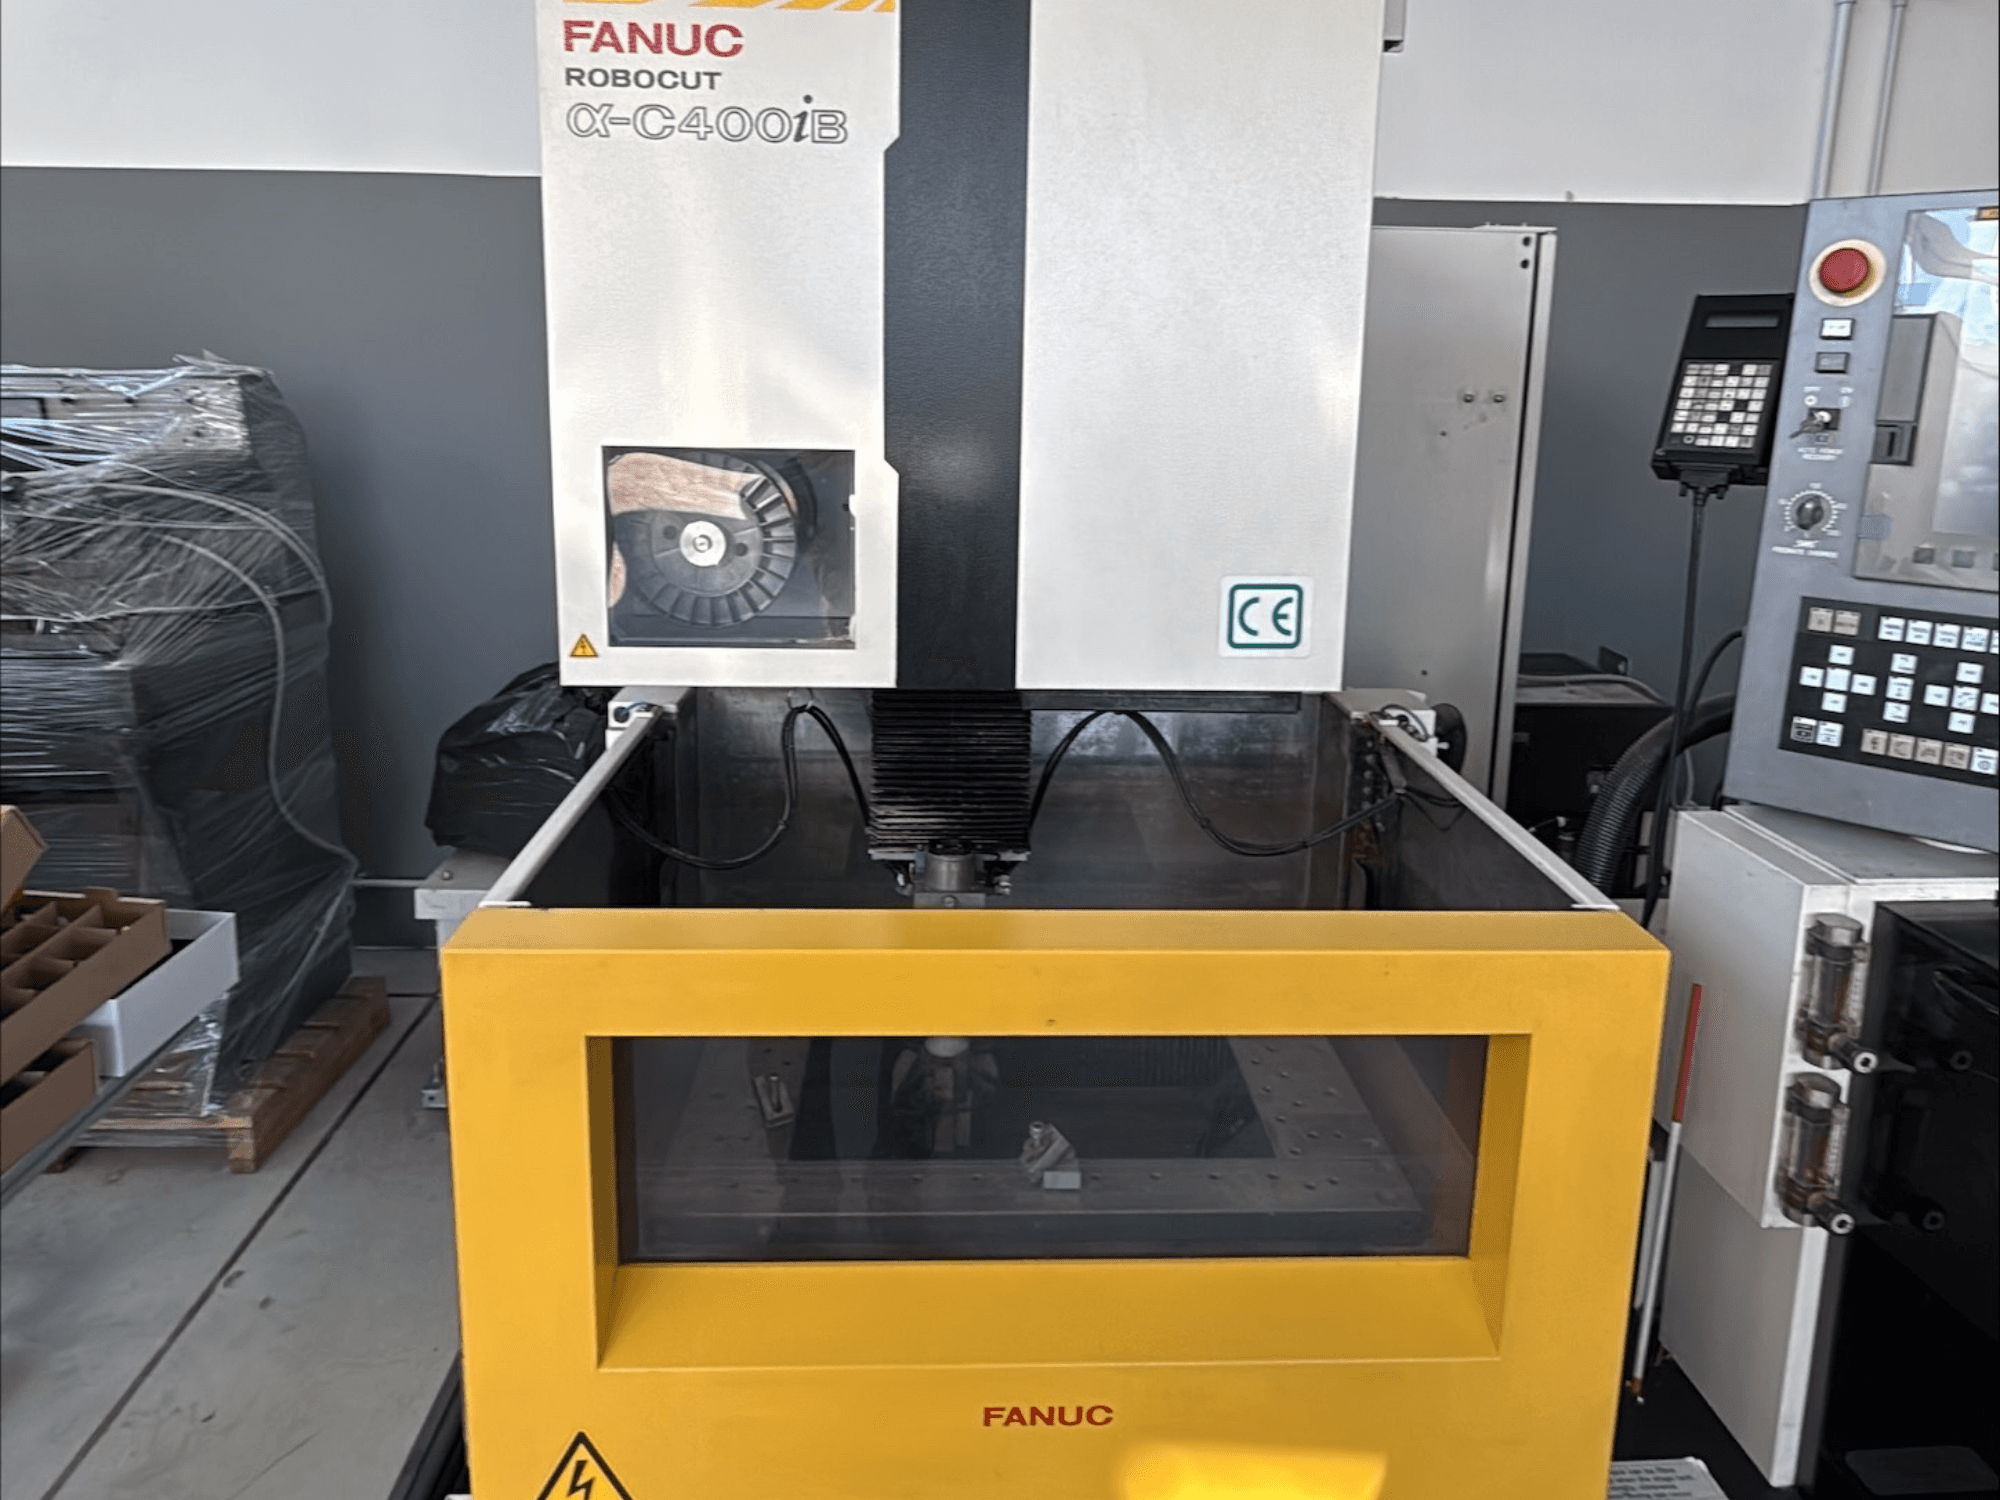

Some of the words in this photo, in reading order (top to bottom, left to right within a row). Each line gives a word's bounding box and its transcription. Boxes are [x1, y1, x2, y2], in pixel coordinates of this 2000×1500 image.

[563, 20, 744, 57] FANUC
[565, 67, 721, 90] ROBOCUT
[1238, 596, 1294, 636] CE
[983, 1405, 1113, 1427] FANUC
